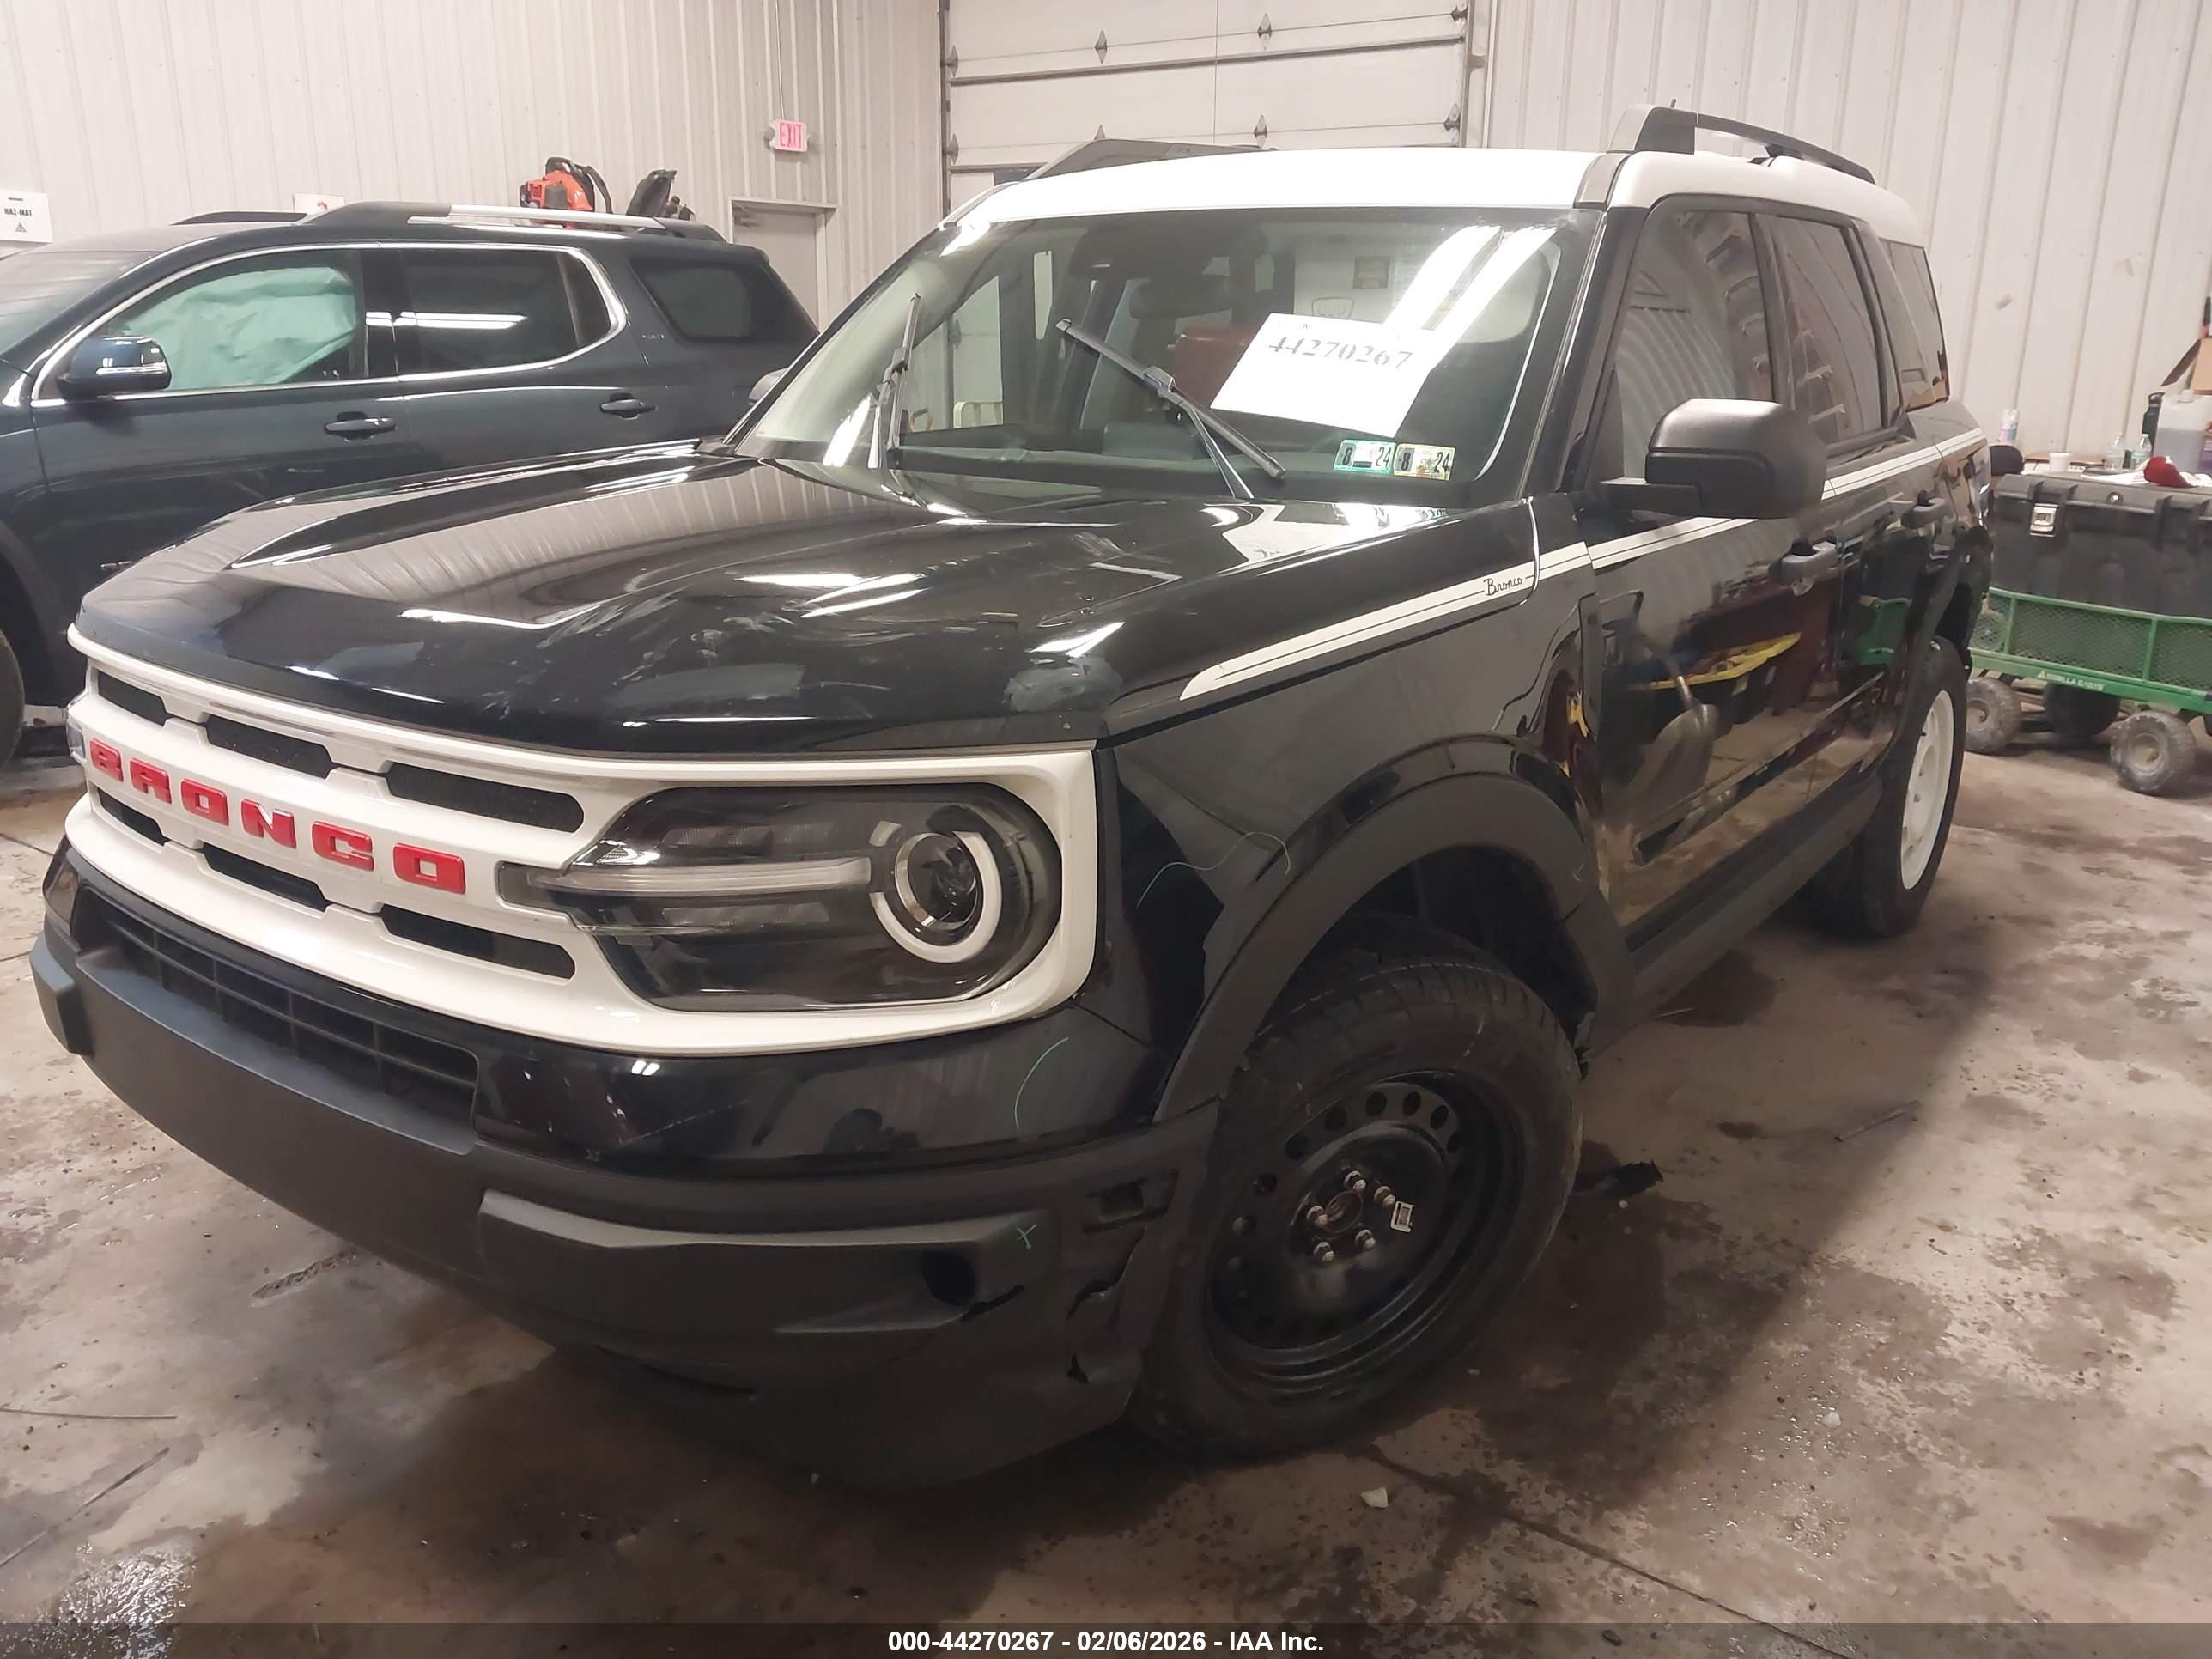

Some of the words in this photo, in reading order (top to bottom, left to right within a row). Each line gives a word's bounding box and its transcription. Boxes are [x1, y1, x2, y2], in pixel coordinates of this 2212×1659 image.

[779, 122, 803, 148] EXIT
[3, 207, 33, 216] HAZ-MAT
[1268, 336, 1414, 369] 44270267
[1341, 447, 1353, 465] 8
[1376, 446, 1391, 468] 24
[1401, 452, 1412, 471] 8
[1433, 452, 1451, 474] 24
[1483, 577, 1523, 596] Bronco
[89, 737, 466, 895] BRONCO
